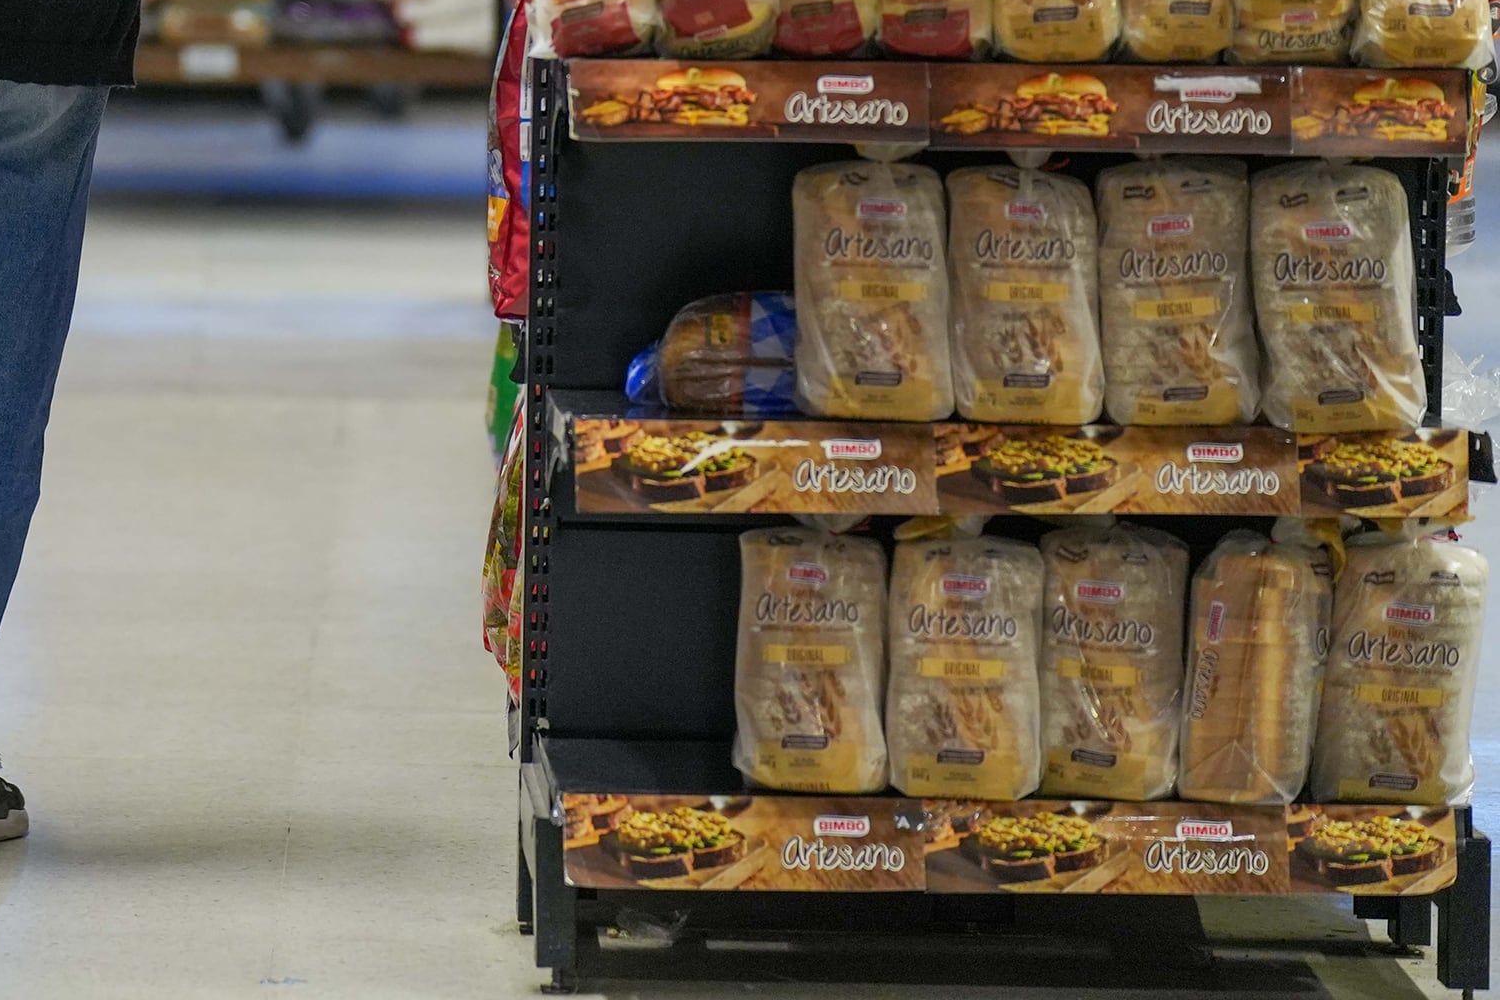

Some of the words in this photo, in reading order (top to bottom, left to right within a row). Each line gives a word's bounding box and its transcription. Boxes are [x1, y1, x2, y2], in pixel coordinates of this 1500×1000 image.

[822, 78, 870, 91] BIMBO
[1151, 220, 1191, 233] BIMBO
[1306, 226, 1351, 238] BIMBO
[831, 443, 878, 456] BIMBO
[1192, 446, 1240, 459] BIMBO
[1386, 607, 1431, 621] BIMBO
[819, 820, 866, 832] BIMBO
[1181, 825, 1229, 837] BIMBO
